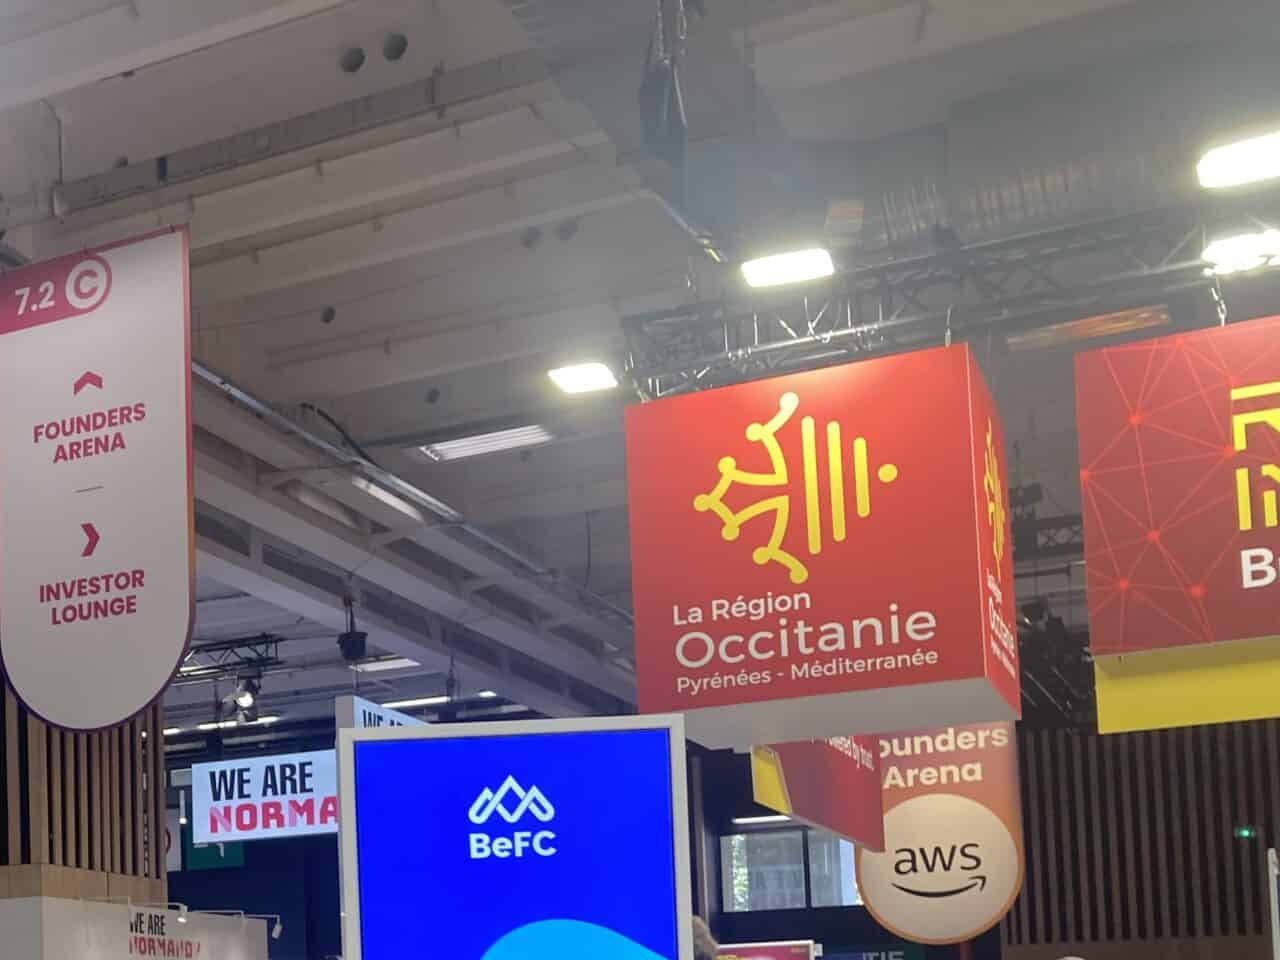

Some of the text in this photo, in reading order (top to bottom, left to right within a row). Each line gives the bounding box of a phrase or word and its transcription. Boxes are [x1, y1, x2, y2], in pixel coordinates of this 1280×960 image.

[14, 281, 56, 316] 7.2
[32, 402, 146, 443] FOUNDERS
[52, 432, 127, 464] ARENA
[38, 569, 145, 603] INVESTOR
[50, 595, 137, 626] LOUNGE
[673, 591, 812, 626] La Région
[675, 603, 937, 668] Occitanie
[676, 668, 771, 695] Pyrénées
[791, 649, 939, 680] Méditerranée
[209, 761, 314, 802] WE ARE
[882, 762, 983, 789] Arena
[209, 796, 338, 834] NORMA
[468, 830, 558, 860] BeFC
[894, 842, 982, 876] aws
[148, 914, 166, 936] ARE
